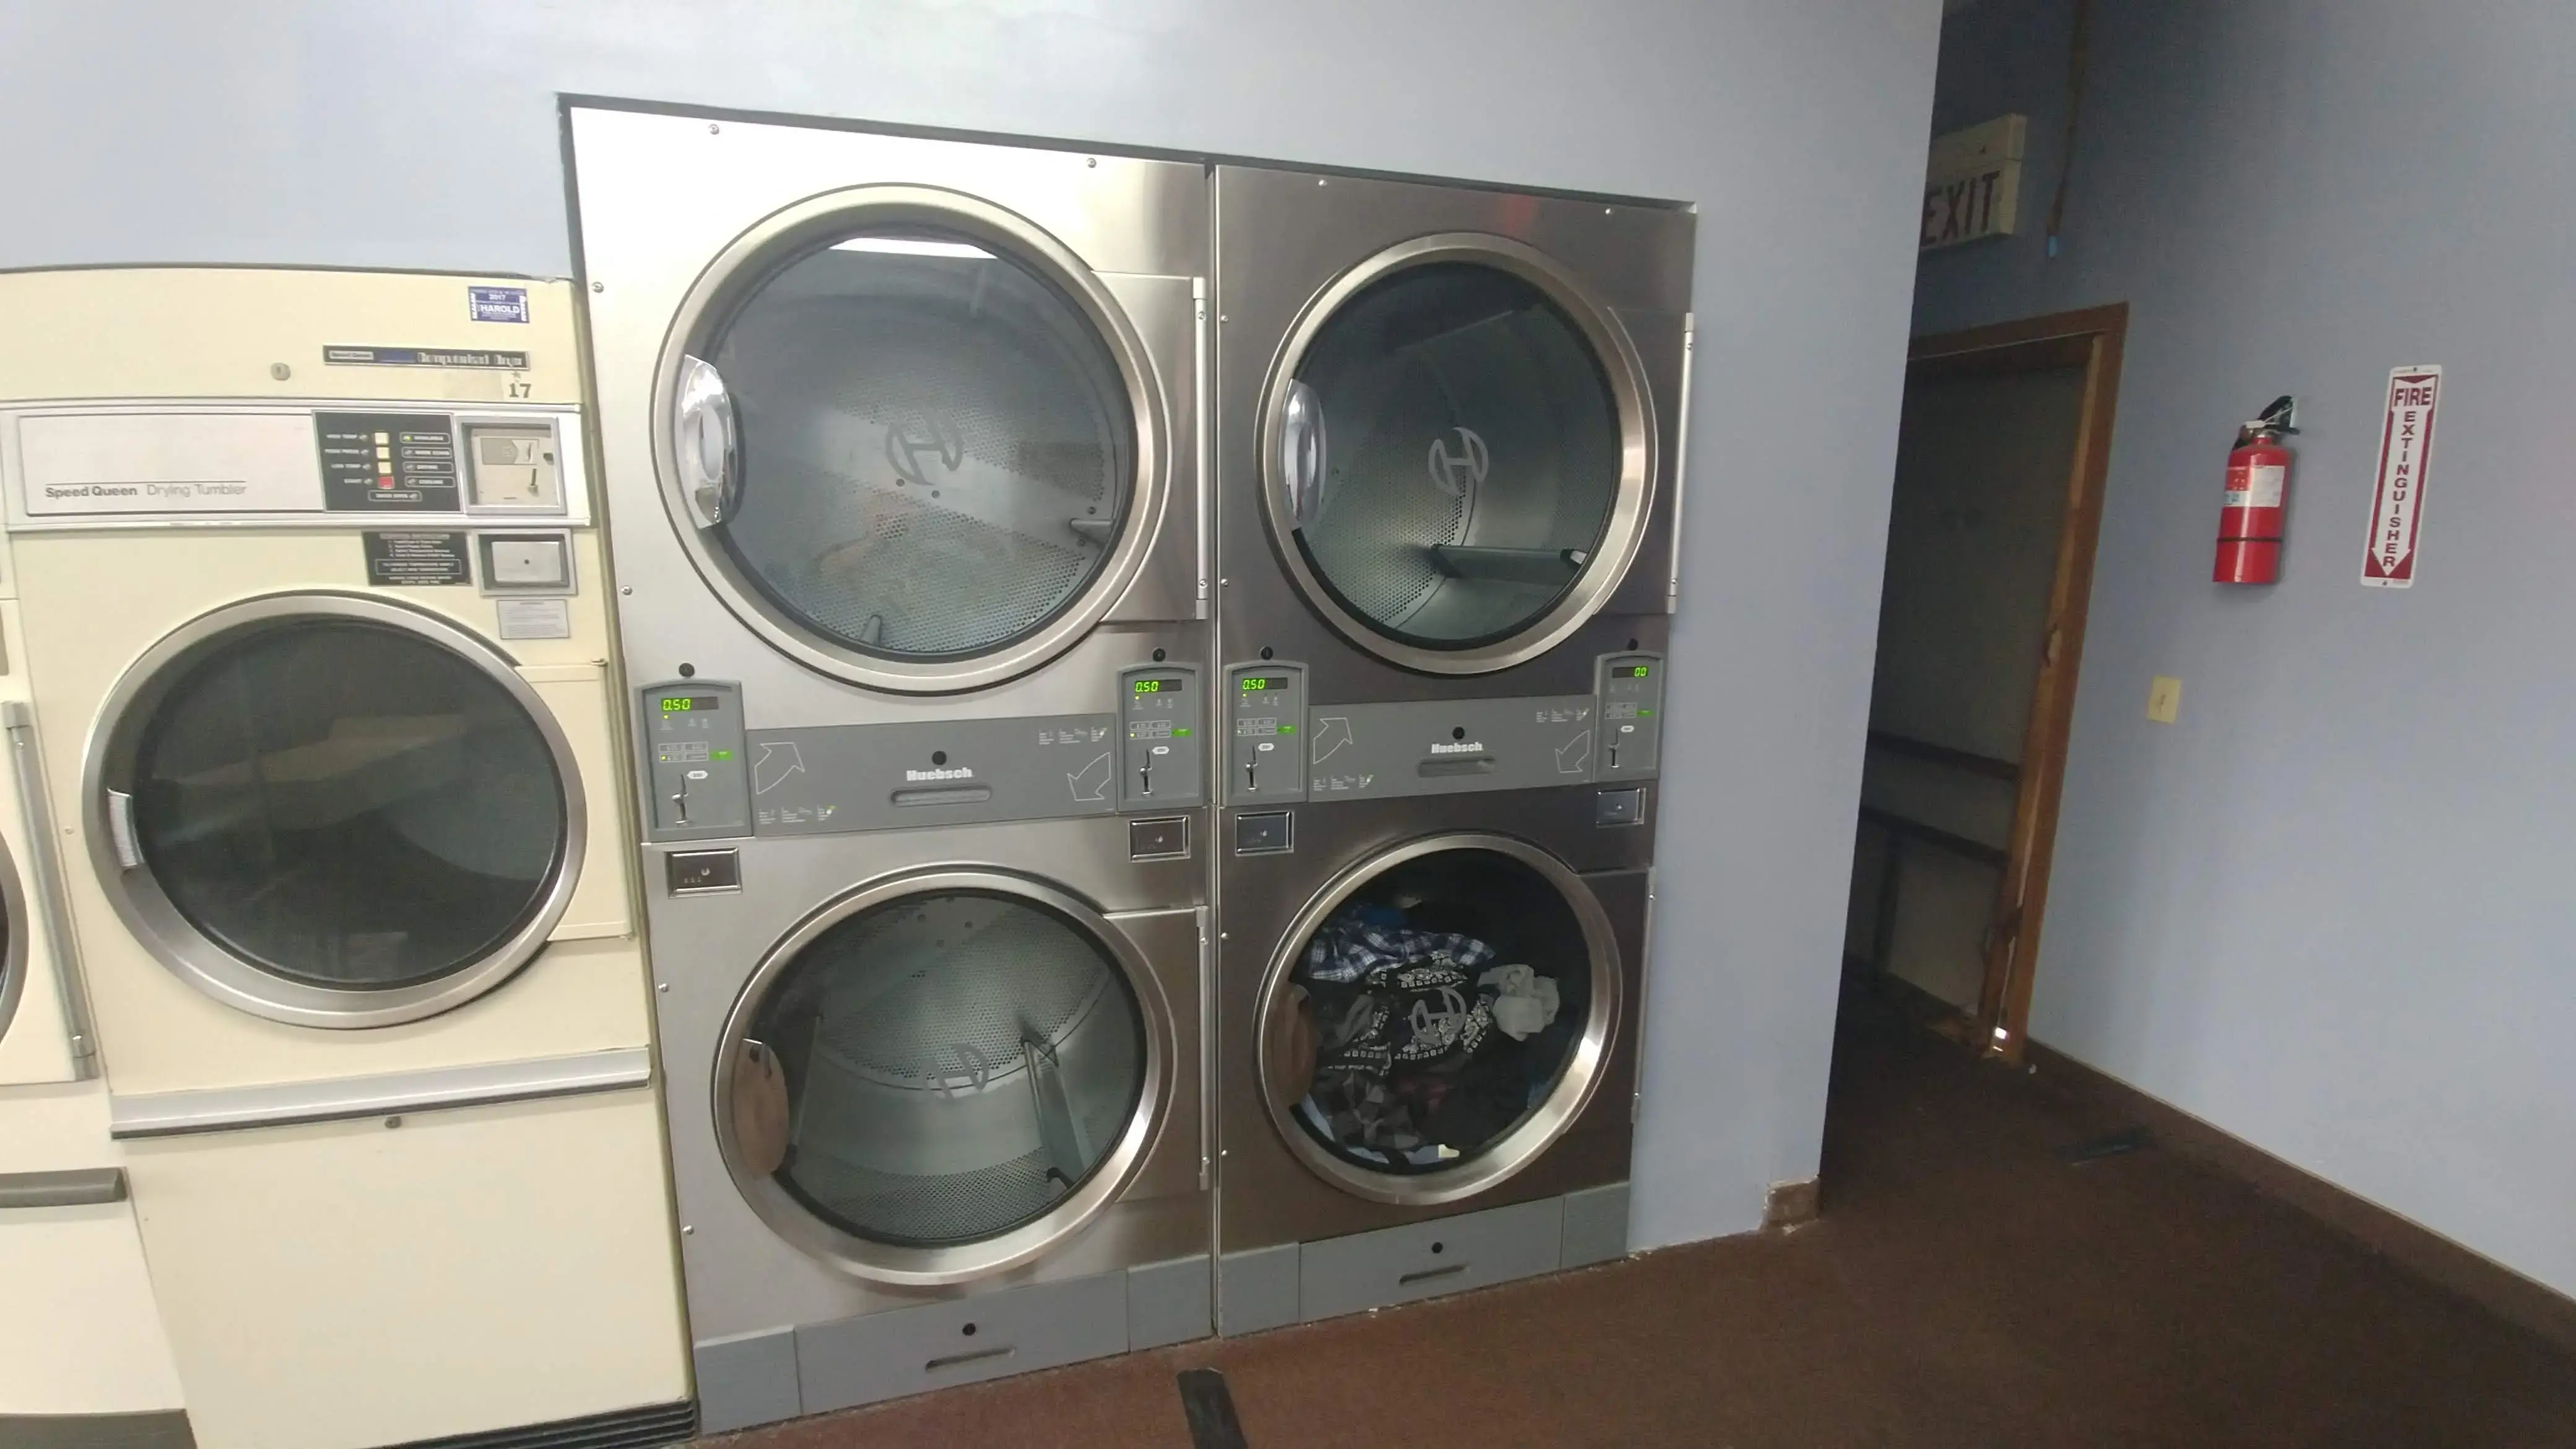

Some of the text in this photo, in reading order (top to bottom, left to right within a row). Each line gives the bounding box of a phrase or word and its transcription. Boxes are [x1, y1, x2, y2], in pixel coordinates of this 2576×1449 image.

[1920, 170, 2000, 246] EXIT
[481, 304, 520, 313] HAROLD
[509, 383, 531, 398] 17
[2394, 386, 2432, 406] FIRE
[45, 483, 246, 499] Speed Queen Drying Tumbler
[2383, 411, 2417, 567] EXTINGUISHER
[1135, 681, 1159, 692] 0.50
[1242, 679, 1265, 690] 0.50
[663, 698, 690, 710] 0.50
[1431, 741, 1483, 754] Huebsch
[906, 767, 973, 781] Huebsch
